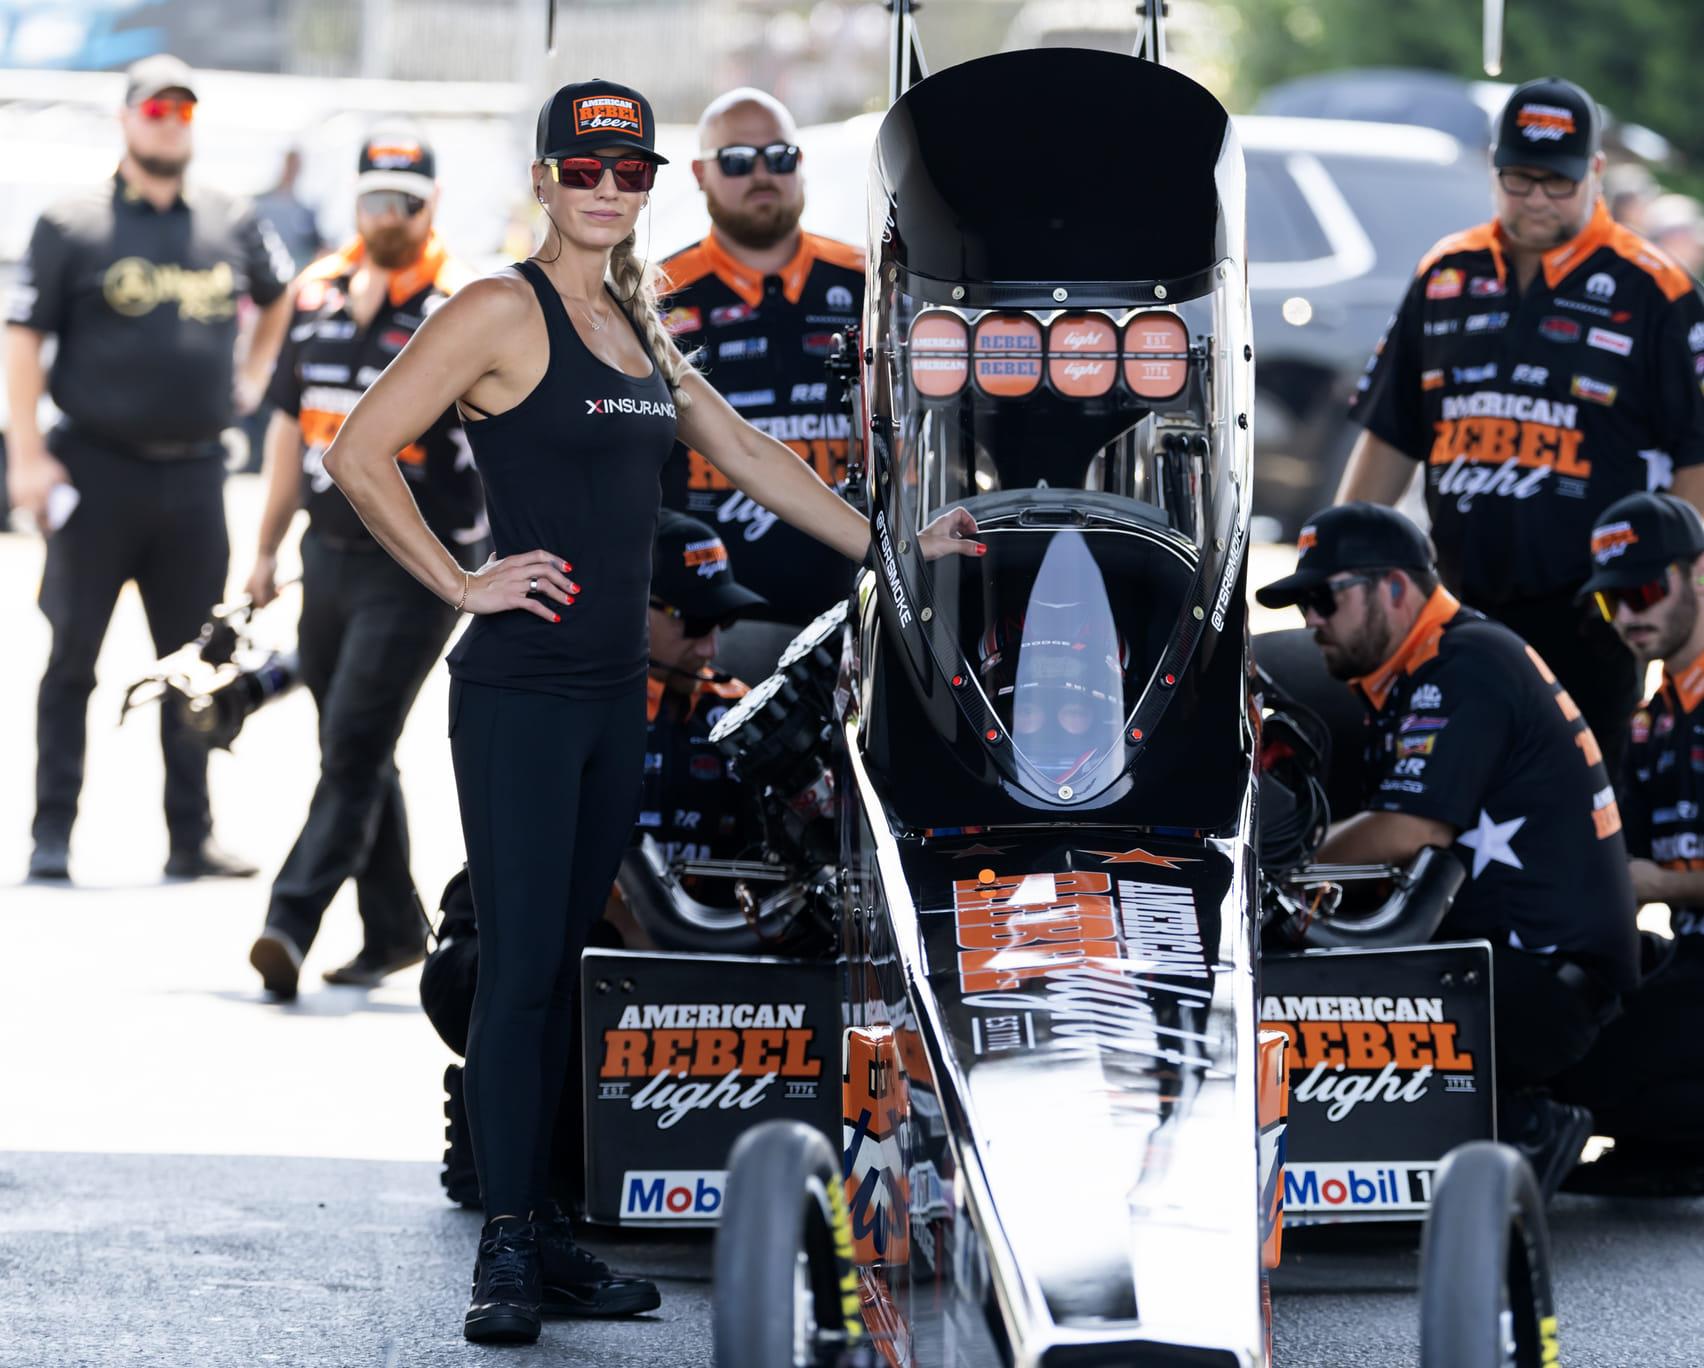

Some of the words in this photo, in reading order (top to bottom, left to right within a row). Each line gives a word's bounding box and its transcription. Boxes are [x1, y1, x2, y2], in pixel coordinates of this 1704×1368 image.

[579, 105, 638, 122] REBEL
[582, 98, 632, 109] AMERICAN
[591, 115, 632, 128] beer
[912, 337, 965, 348] AMERICAN
[981, 335, 1037, 349] REBEL
[1063, 331, 1103, 350] light
[981, 362, 1038, 375] REBEL
[1063, 362, 1103, 380] light
[751, 412, 852, 440] ERICAN
[1438, 454, 1552, 513] light
[1118, 879, 1209, 979] AMERICAN
[618, 1003, 806, 1030] AMERICAN
[1260, 996, 1444, 1023] AMERICAN
[599, 1028, 822, 1078] REBEL
[602, 1086, 624, 1096] EST
[630, 1068, 779, 1130] light
[1294, 1061, 1434, 1122] light
[627, 1178, 722, 1214] Mob
[1284, 1169, 1400, 1205] Mobil
